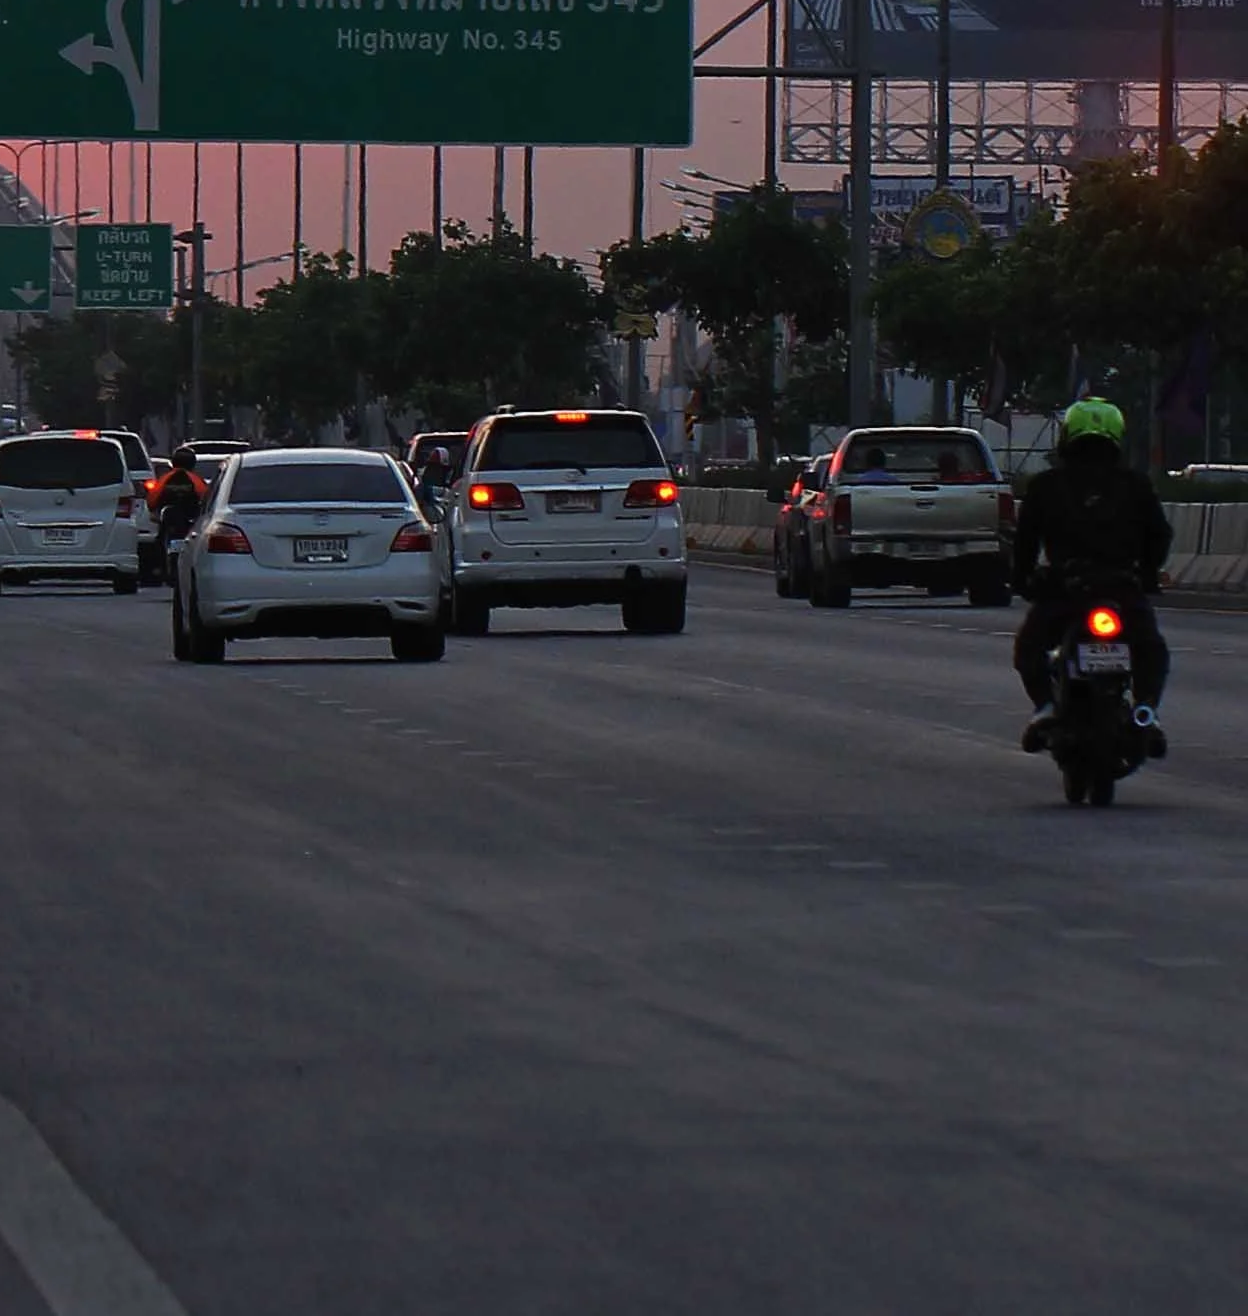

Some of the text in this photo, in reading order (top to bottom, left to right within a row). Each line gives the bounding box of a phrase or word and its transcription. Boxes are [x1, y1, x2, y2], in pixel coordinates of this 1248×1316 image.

[336, 27, 562, 56] Highway No. 345
